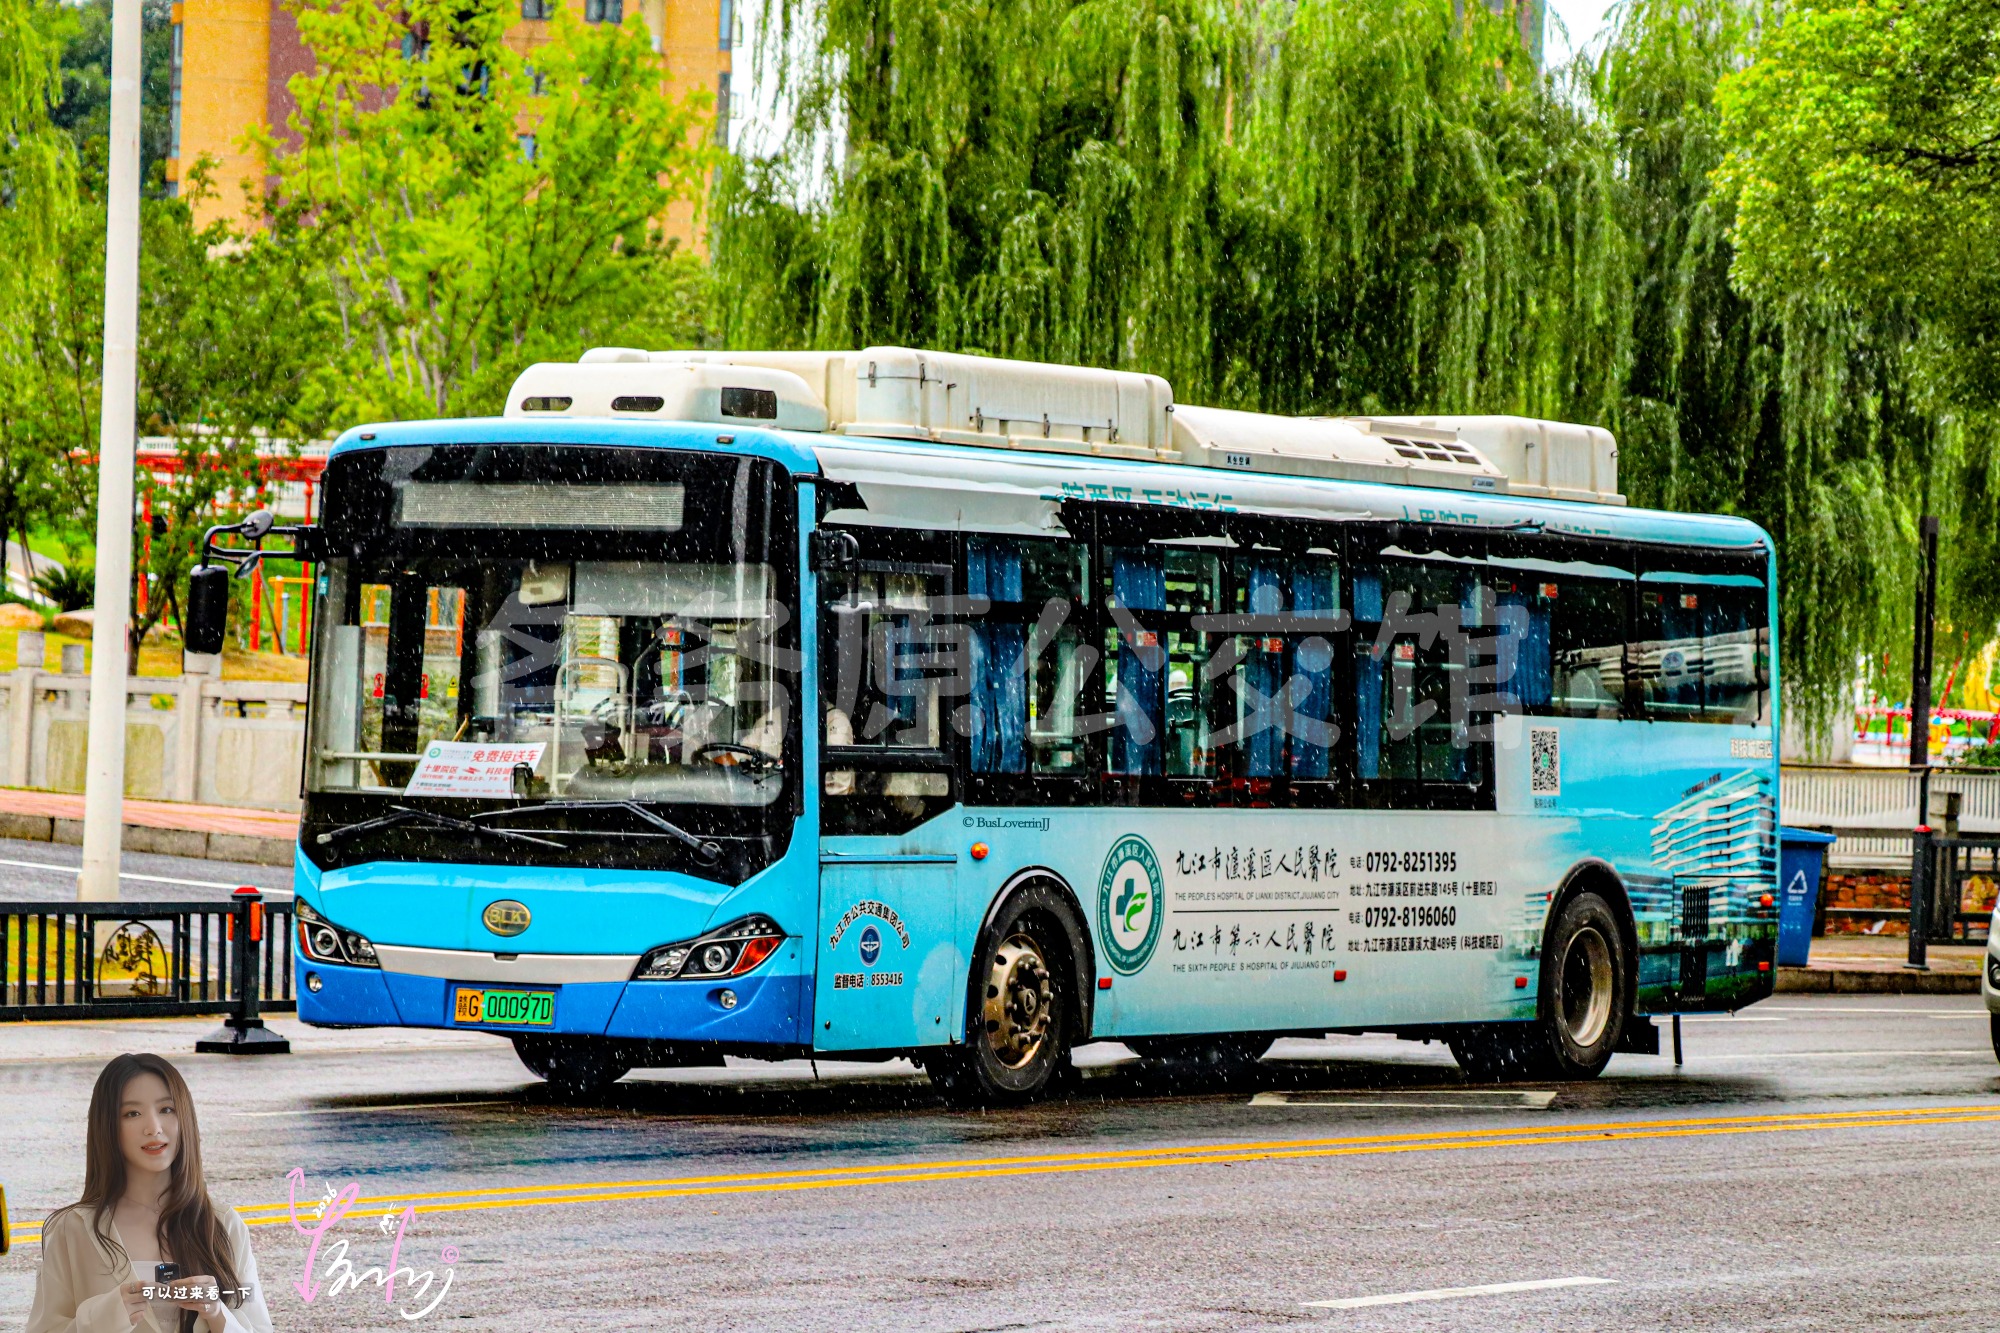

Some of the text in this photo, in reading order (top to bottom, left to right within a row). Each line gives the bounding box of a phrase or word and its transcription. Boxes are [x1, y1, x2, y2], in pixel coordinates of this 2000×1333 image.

[471, 749, 540, 763] 免费接送车
[1366, 851, 1457, 873] 0792-8251395
[1175, 892, 1186, 900] THE
[1188, 892, 1216, 900] PEOPLE'S
[1217, 891, 1245, 900] HOSPITAL
[1246, 891, 1254, 900] OF
[1255, 891, 1273, 900] LIANXI
[1326, 891, 1339, 899] CITY
[829, 900, 911, 950] 九江市公共交通集团公司
[1365, 906, 1457, 928] 0792-8196060
[1173, 963, 1186, 973] THE
[1188, 963, 1208, 973] SIXTH
[1246, 962, 1279, 971] HOSPITAL
[1280, 961, 1289, 970] OF
[1290, 960, 1320, 970] JIUJIANG
[1321, 960, 1336, 969] CITY
[487, 995, 551, 1020] 00097D
